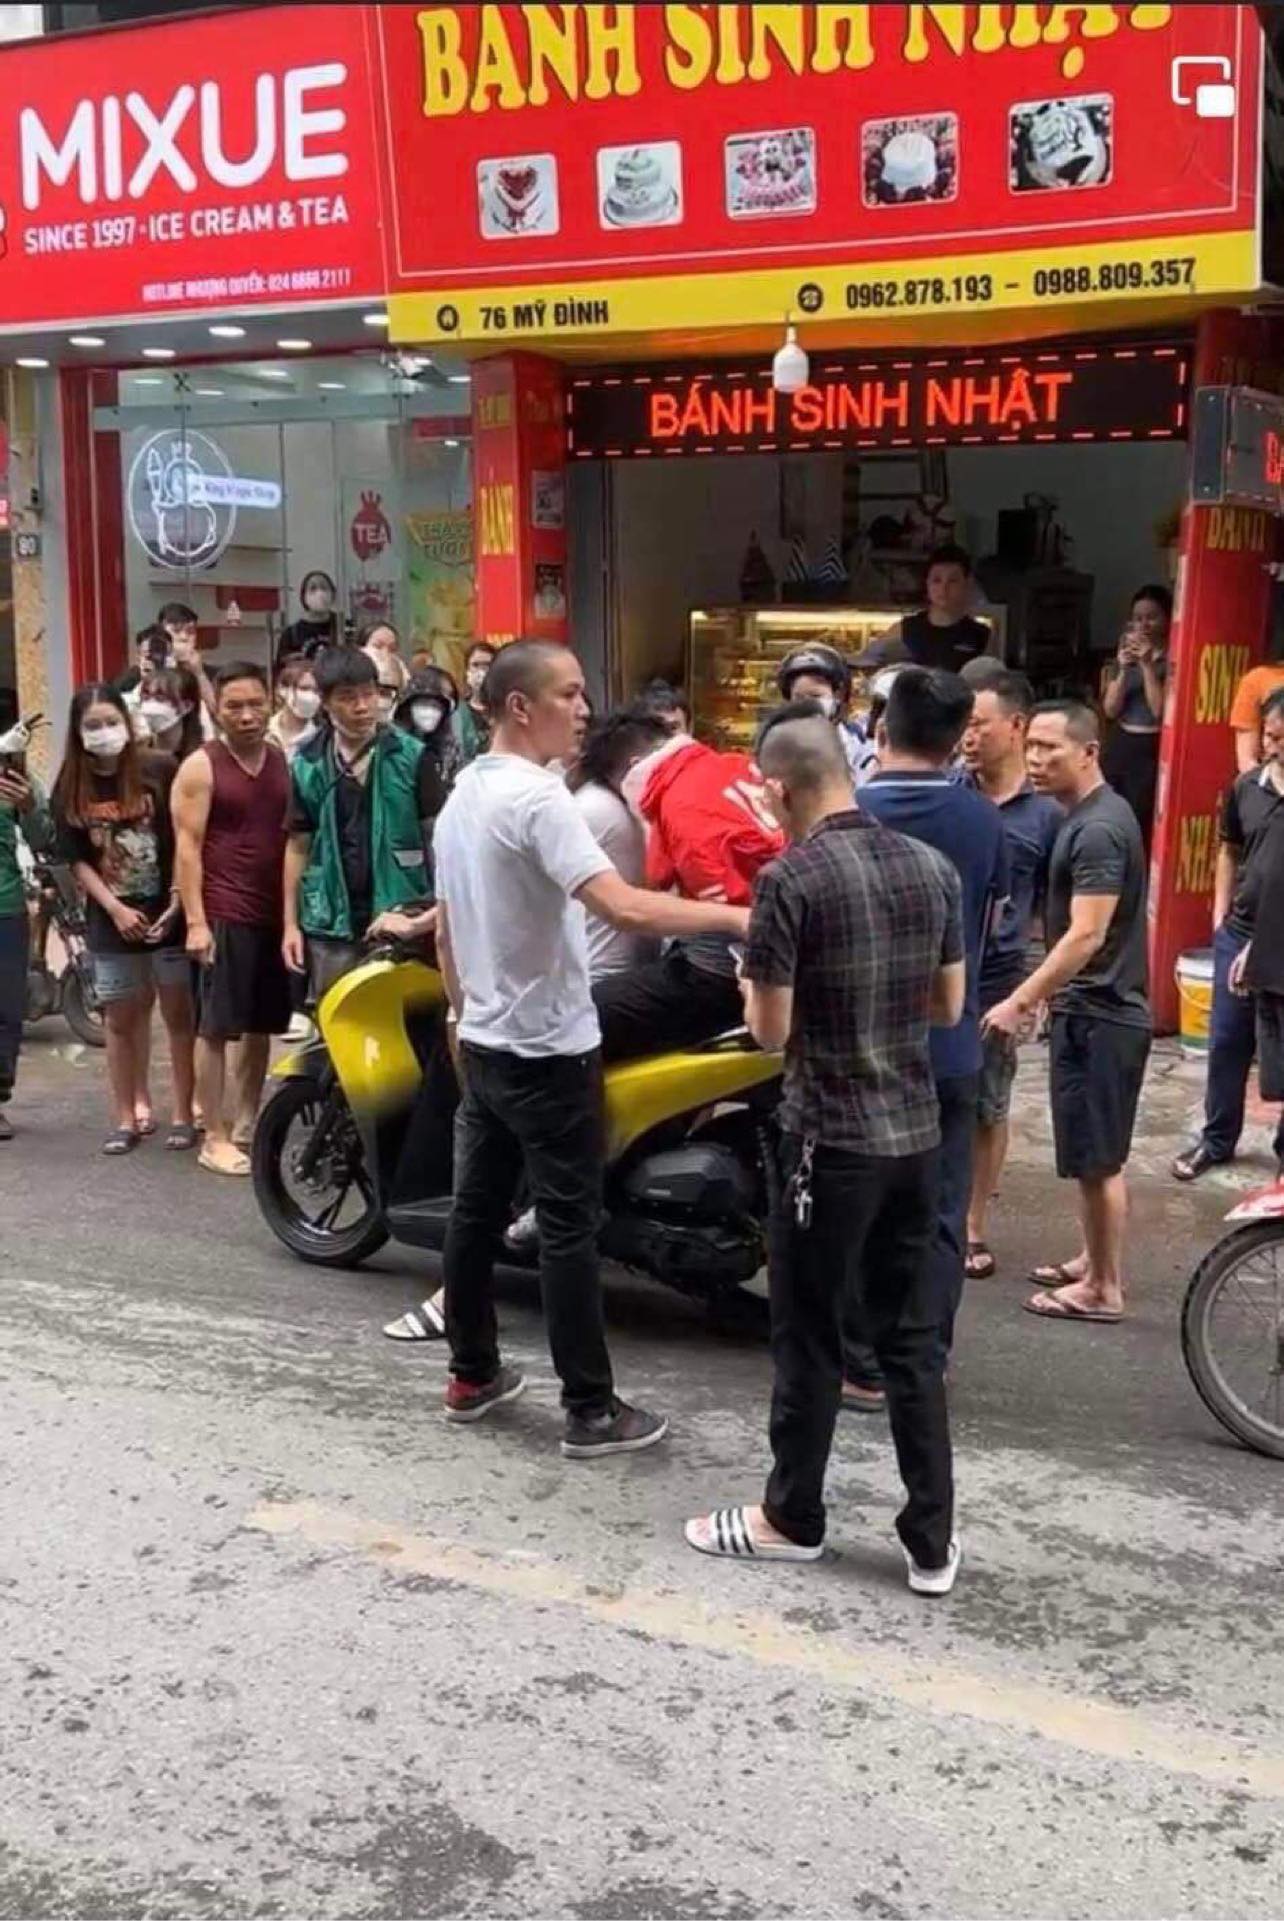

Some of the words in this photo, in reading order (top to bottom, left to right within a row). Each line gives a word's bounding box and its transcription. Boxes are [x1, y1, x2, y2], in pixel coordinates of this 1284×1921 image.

[20, 63, 348, 211] MIXUE
[24, 223, 88, 255] SINCE
[92, 215, 136, 248] 1997
[150, 211, 184, 242] ICE
[190, 203, 273, 238] CREAM
[277, 200, 295, 229] &
[297, 195, 349, 227] TEA
[846, 275, 992, 309] 0962.878.193
[1034, 257, 1196, 297] 0988.809.357
[480, 307, 506, 330] 76
[513, 299, 546, 327] MỸ
[553, 297, 609, 326] ĐÌNH
[649, 377, 776, 437] BÁNH
[790, 380, 908, 431] SINH
[926, 367, 1073, 431] NHẬT
[354, 522, 390, 544] TEA
